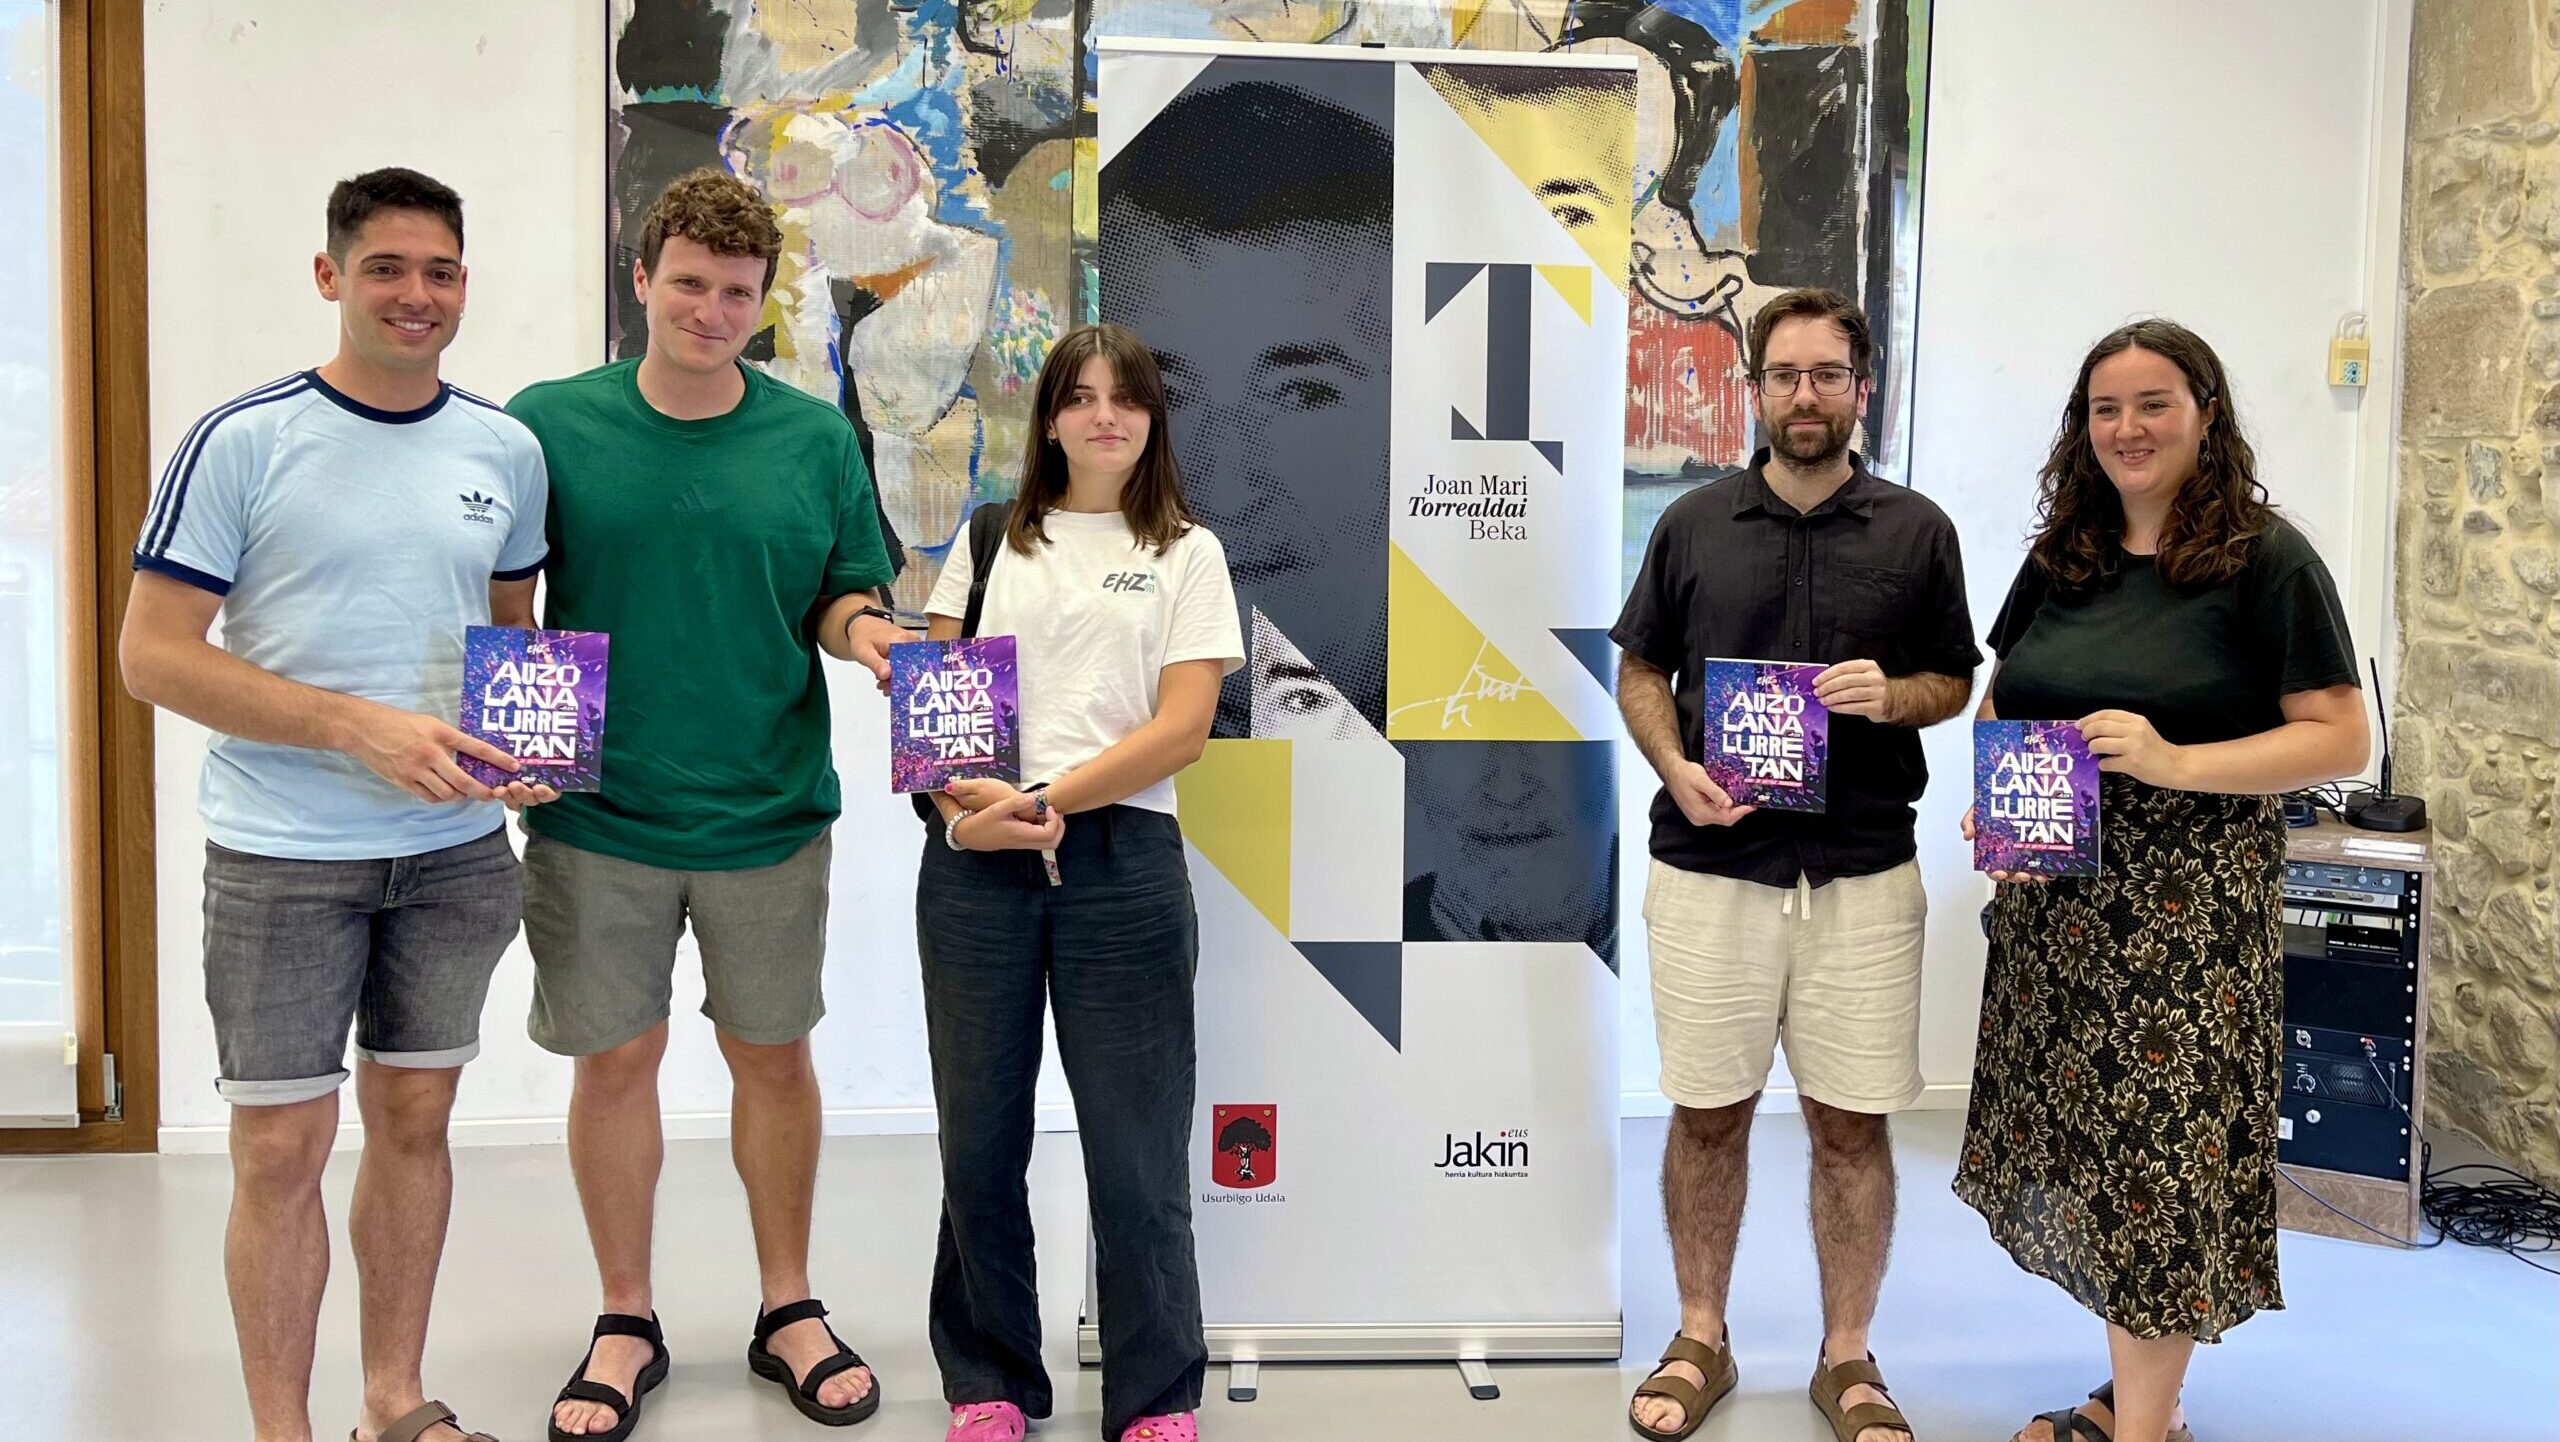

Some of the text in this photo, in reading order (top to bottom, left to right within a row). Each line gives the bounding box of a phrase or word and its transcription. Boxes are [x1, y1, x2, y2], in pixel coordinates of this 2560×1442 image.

[1424, 474, 1528, 496] Joan Mari
[463, 513, 494, 525] adidas
[1408, 496, 1528, 518] Torrealdai
[1468, 519, 1528, 540] Beka
[1102, 571, 1148, 593] EHZ
[492, 661, 582, 687] AUZO
[915, 668, 994, 693] AUZO
[484, 684, 579, 710] LANA
[909, 690, 994, 715] LANA
[1728, 691, 1806, 715] AUZO
[482, 708, 579, 734] LURRE
[909, 712, 995, 738] LURRE
[1723, 712, 1804, 737] LANA
[507, 734, 576, 759] TAN
[931, 734, 994, 759] TAN
[1722, 734, 1804, 758] LURRE
[1743, 756, 1803, 781] TAN
[1996, 752, 2074, 775] AUZO
[1991, 774, 2074, 797] LANA
[1990, 797, 2074, 820] LURRE
[2010, 821, 2074, 844] TAN
[1434, 1131, 1528, 1168] Jakin
[1202, 1192, 1286, 1205] Usurbilgo Udala
